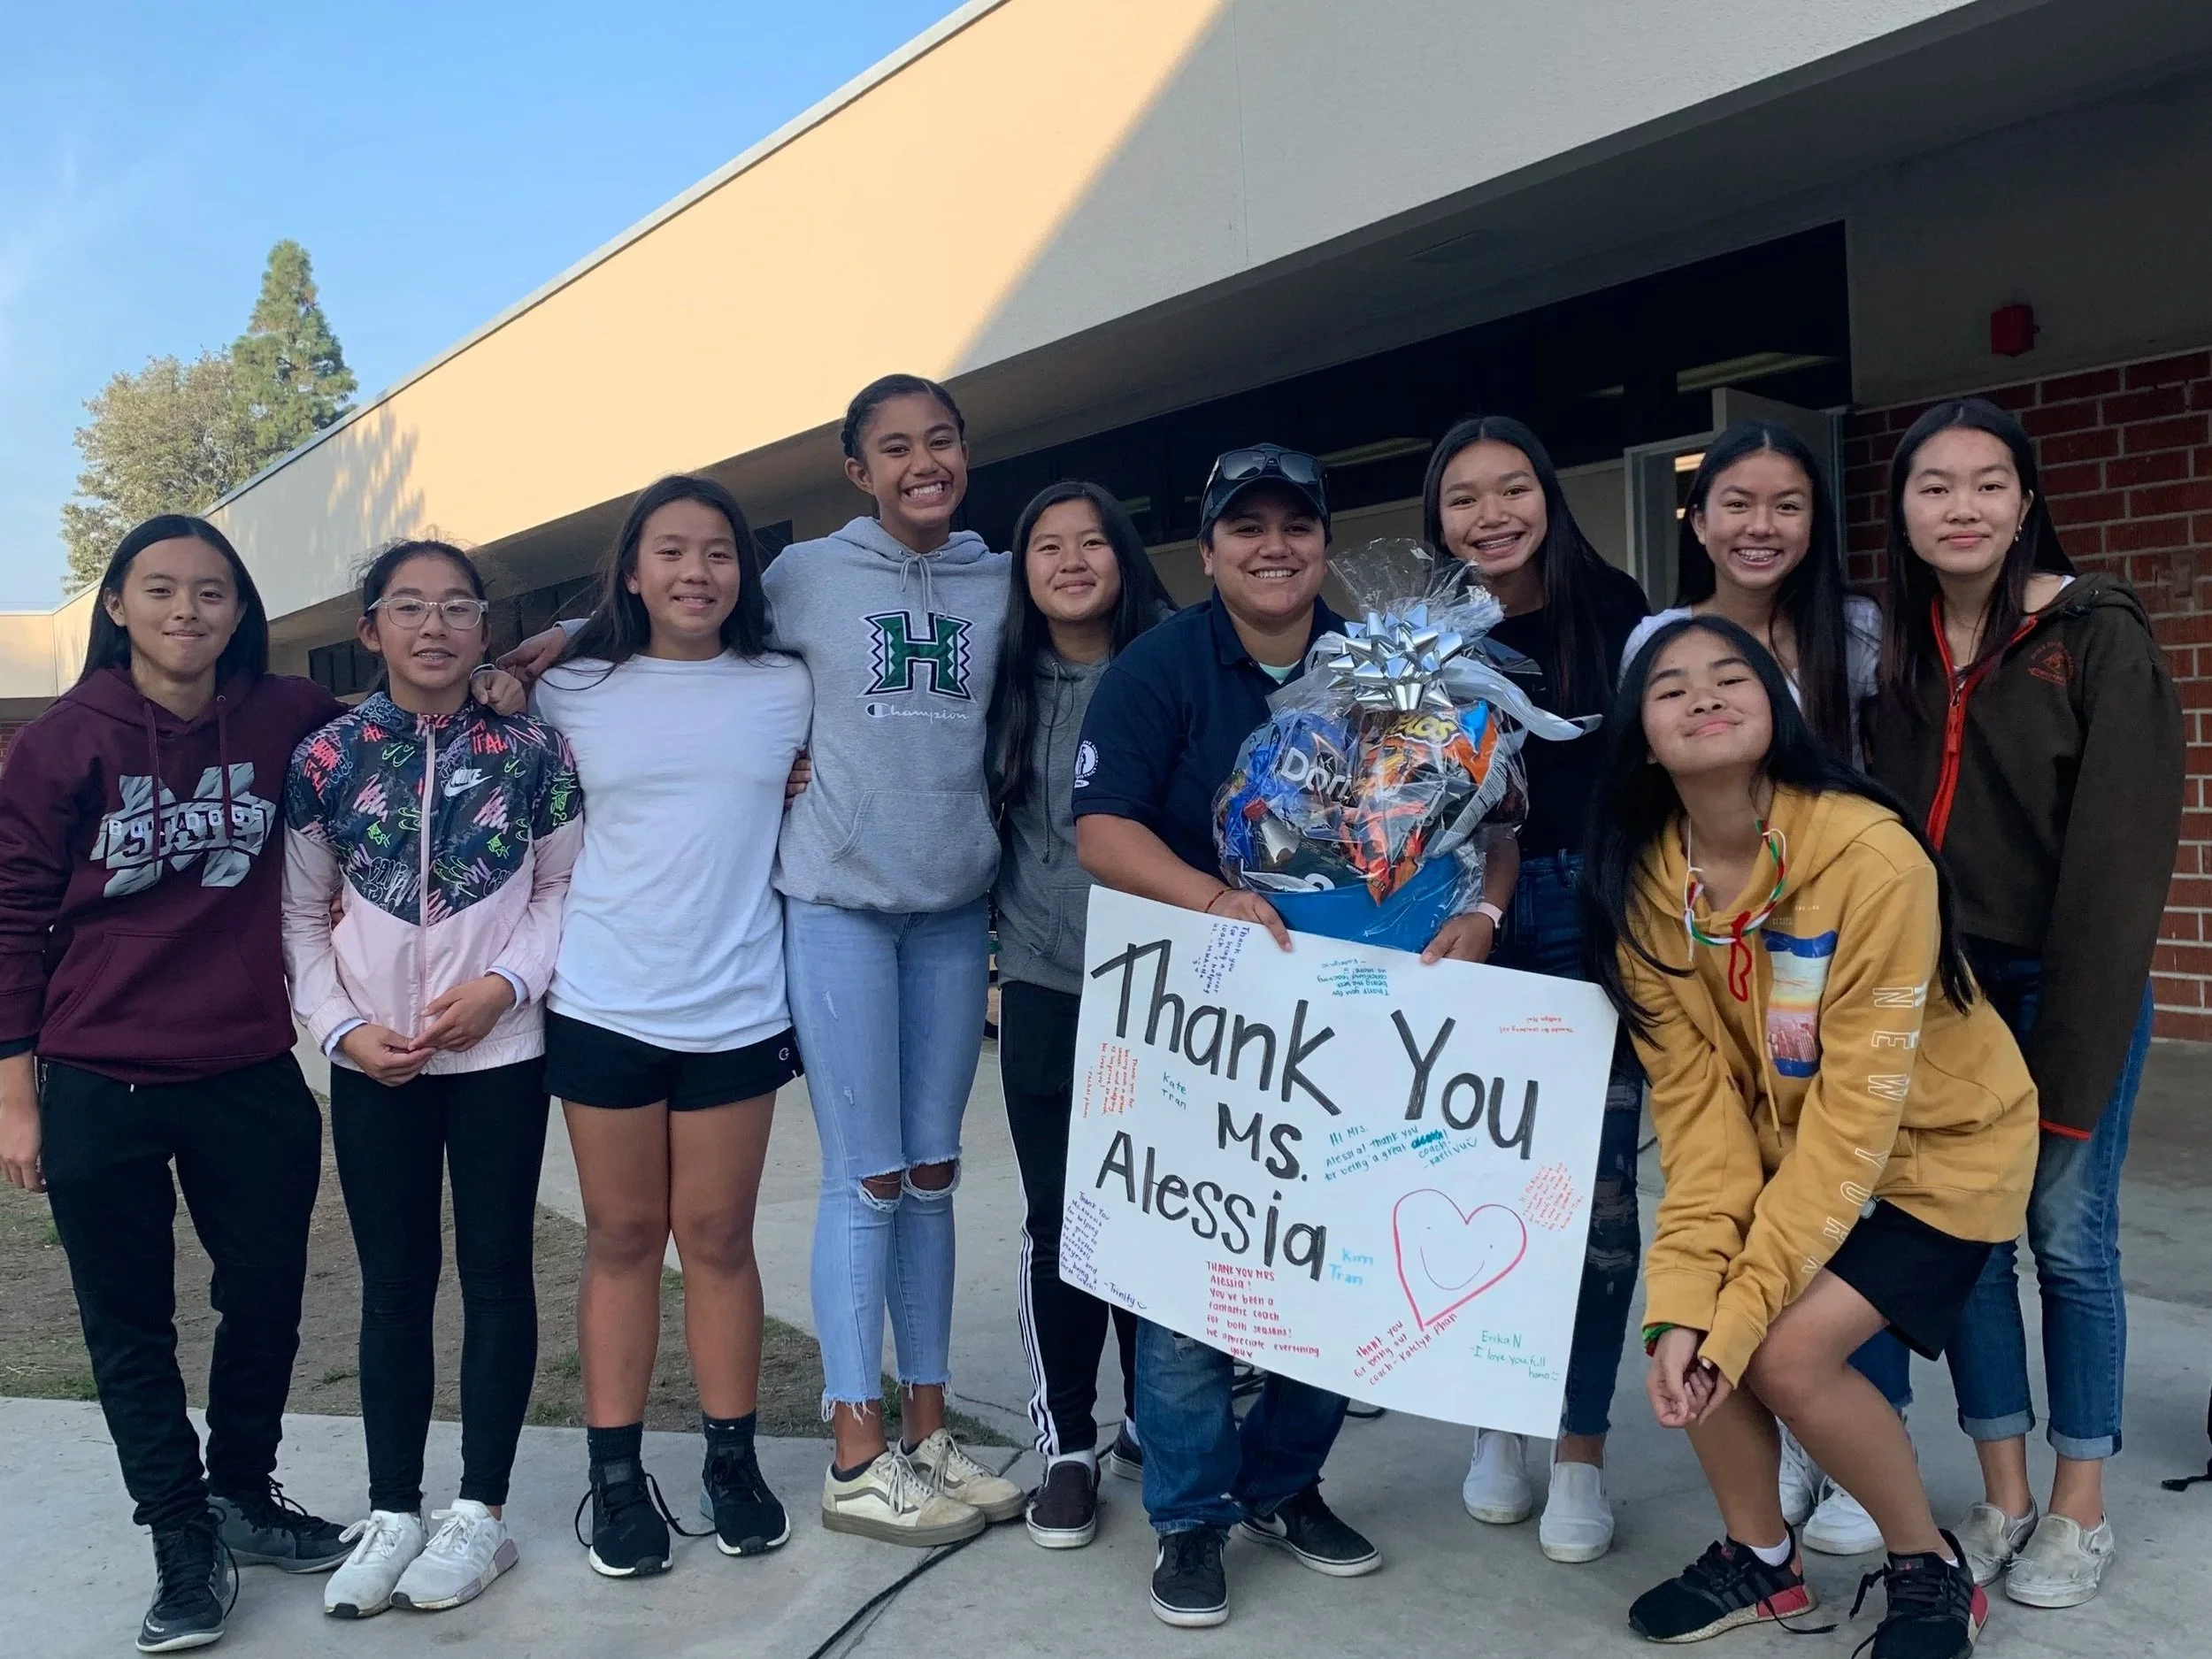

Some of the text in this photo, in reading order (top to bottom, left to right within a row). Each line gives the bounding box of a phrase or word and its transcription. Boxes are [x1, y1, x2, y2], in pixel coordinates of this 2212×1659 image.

[857, 609, 977, 703] H
[865, 702, 970, 724] Champion
[449, 768, 482, 787] NIKE
[1091, 939, 1539, 1160] Thank You
[1868, 979, 1929, 1103] NEW
[1401, 1125, 1418, 1139] you
[1079, 1191, 1096, 1209] Thank
[1094, 1130, 1328, 1282] Alessia
[1206, 1260, 1234, 1275] THANK
[1235, 1266, 1253, 1279] YOU
[1241, 1294, 1264, 1306] been
[1267, 1297, 1274, 1306] a
[1356, 1320, 1403, 1359] thank you
[1481, 1330, 1522, 1348] Erika N
[1367, 1347, 1394, 1367] being
[1487, 1348, 1505, 1363] love
